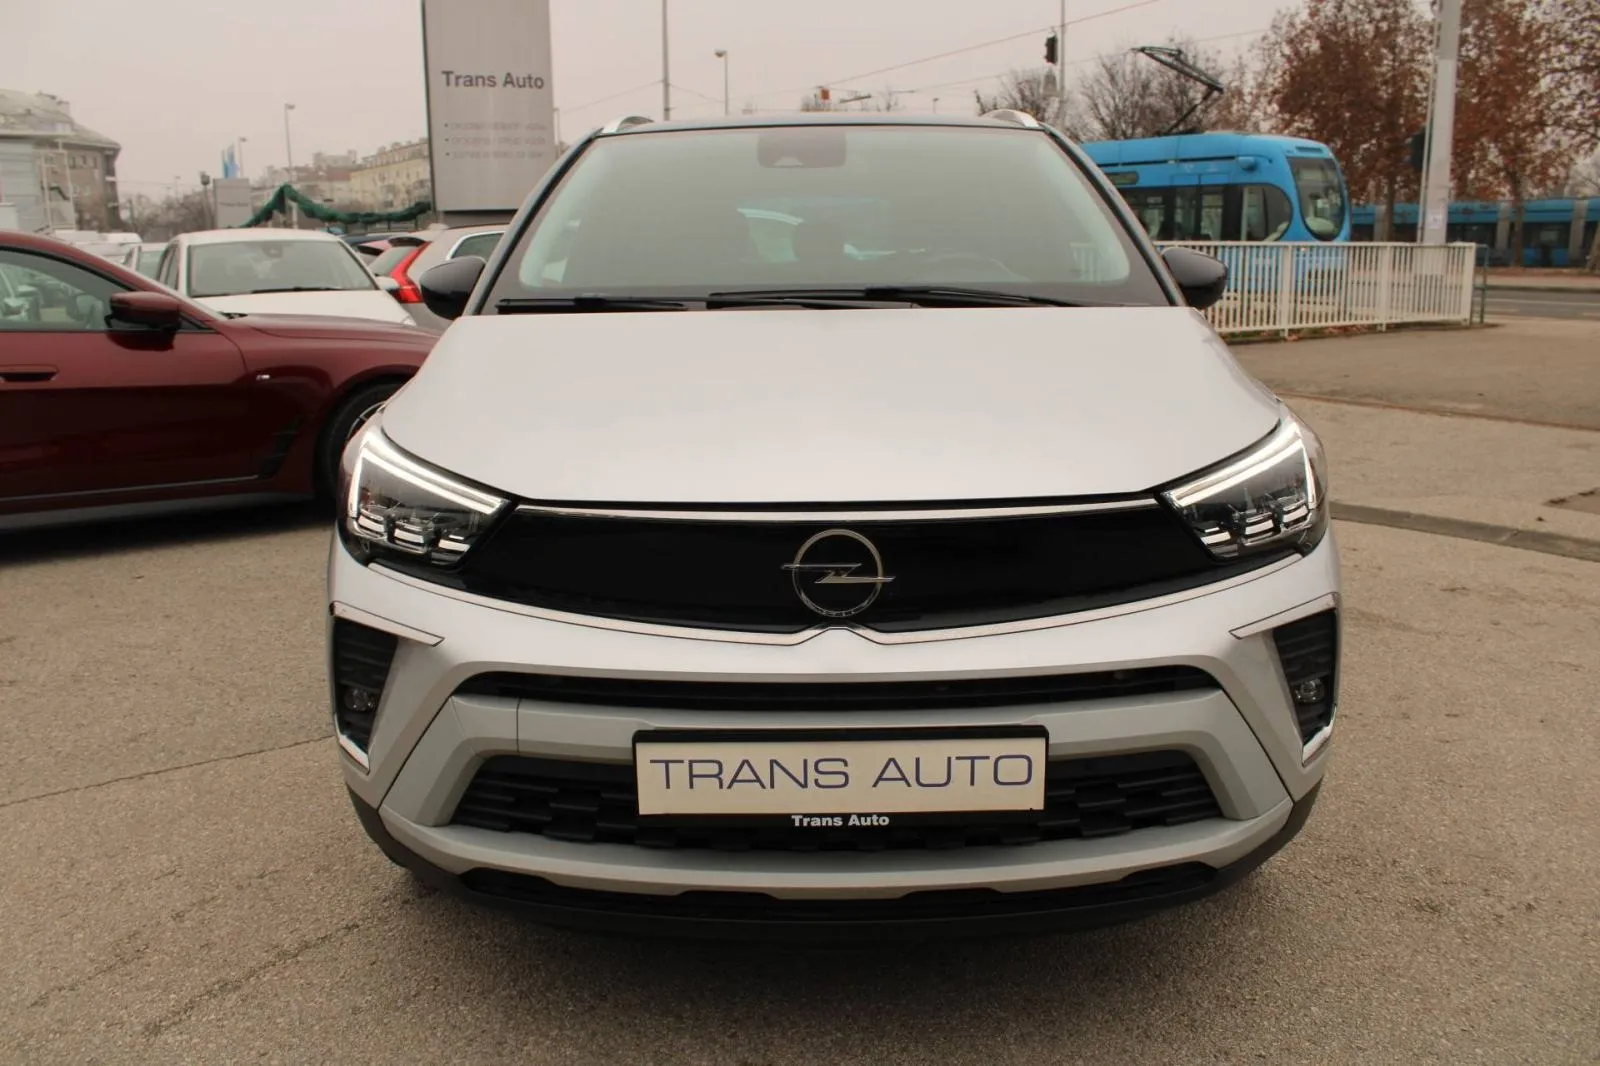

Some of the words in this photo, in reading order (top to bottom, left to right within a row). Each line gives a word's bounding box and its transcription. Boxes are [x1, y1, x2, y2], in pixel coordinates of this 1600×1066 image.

[441, 70, 497, 88] Trans
[502, 72, 545, 90] Auto
[650, 757, 850, 790] TRANS
[871, 754, 1033, 788] AUTO
[791, 814, 843, 827] Trans
[848, 814, 890, 827] Auto
